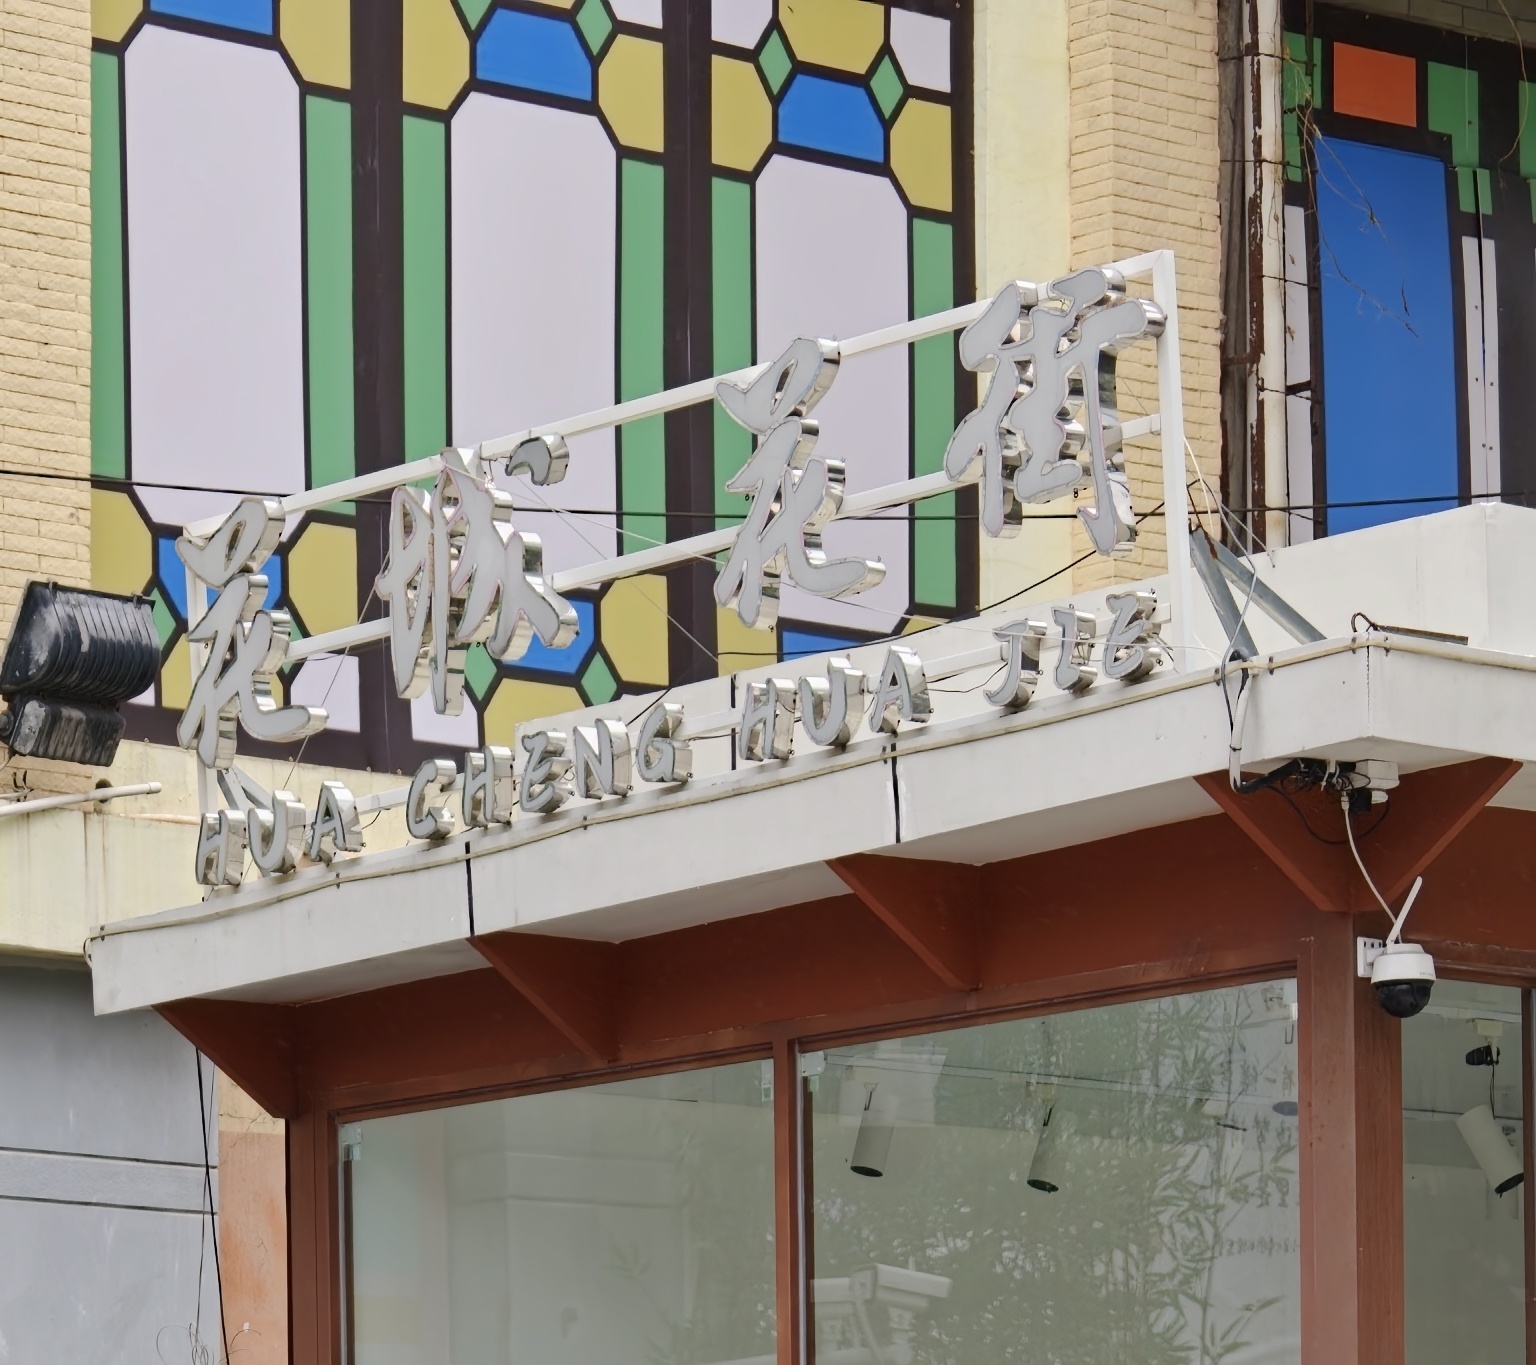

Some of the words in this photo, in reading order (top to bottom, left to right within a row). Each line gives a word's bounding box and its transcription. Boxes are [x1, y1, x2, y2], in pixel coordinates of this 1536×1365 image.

[194, 780, 364, 889] HUA
[406, 703, 694, 842] CHENG
[739, 644, 932, 762] HUA
[982, 590, 1164, 709] JIE
